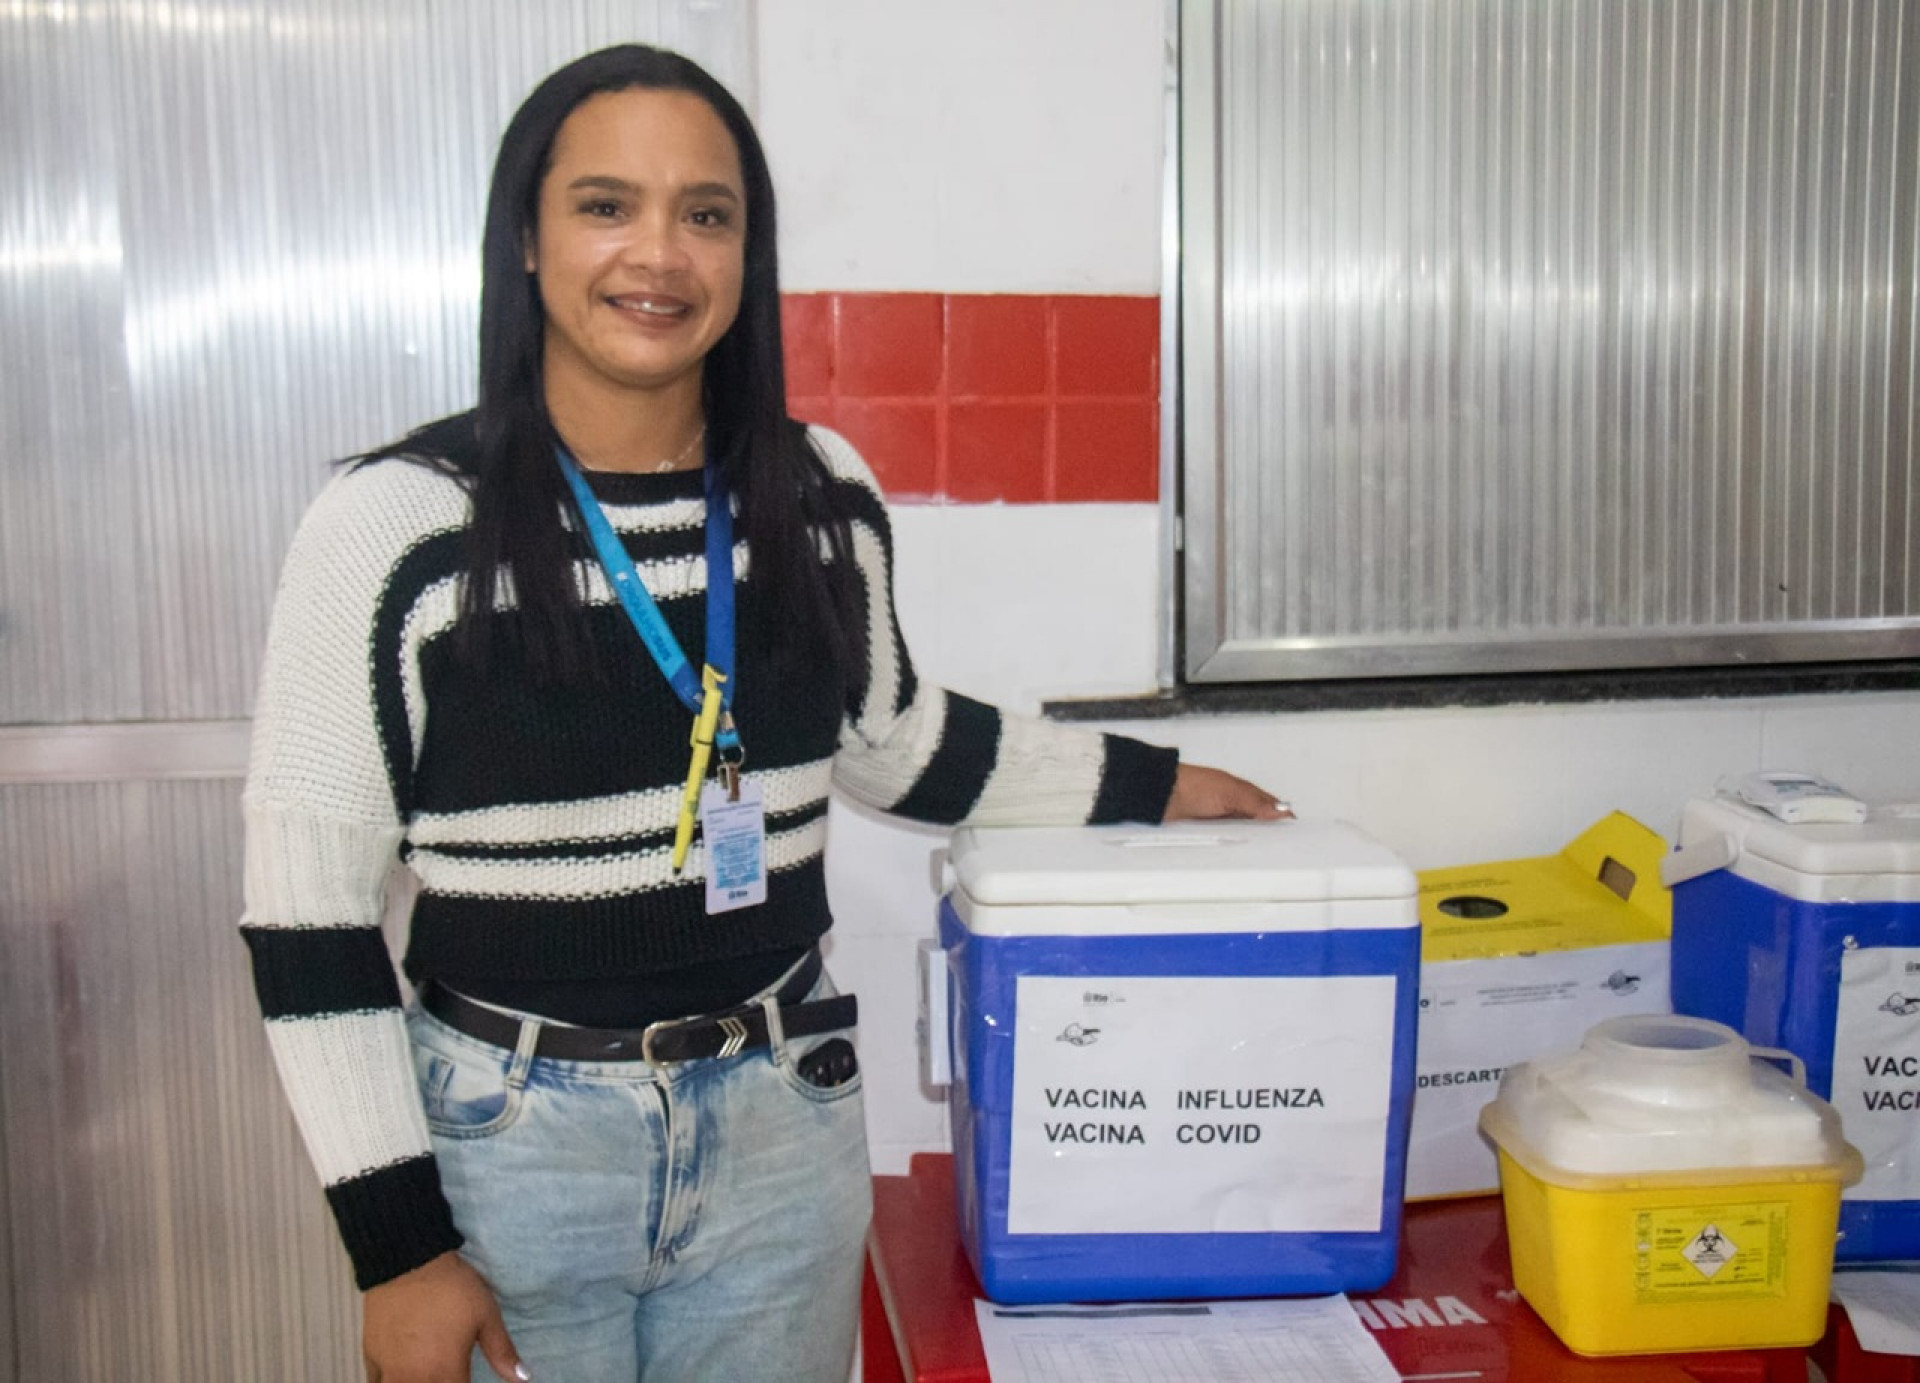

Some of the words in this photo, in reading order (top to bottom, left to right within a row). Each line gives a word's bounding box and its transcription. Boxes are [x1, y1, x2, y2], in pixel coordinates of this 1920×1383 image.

[1418, 1067, 1508, 1088] DESCART
[1045, 1088, 1147, 1110] VACINA
[1177, 1088, 1325, 1110] INFLUENZA
[1044, 1122, 1146, 1144] VACINA
[1176, 1124, 1262, 1144] COVID
